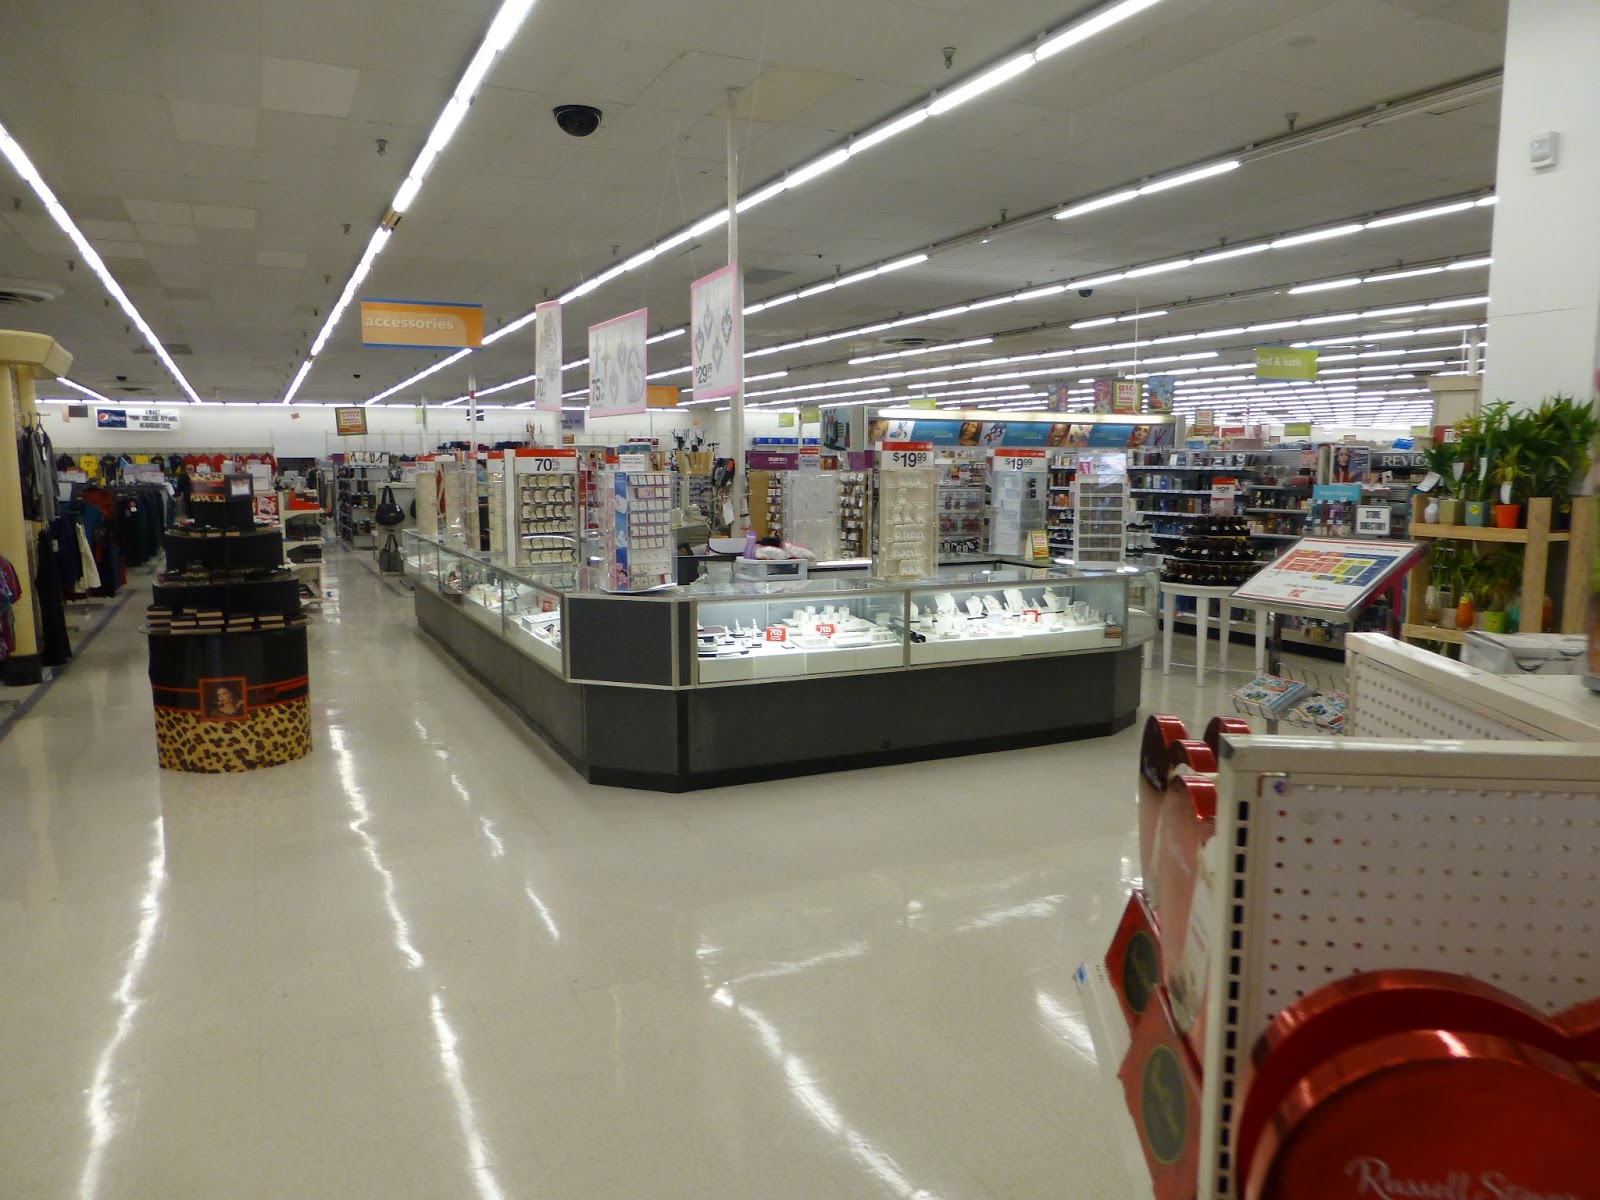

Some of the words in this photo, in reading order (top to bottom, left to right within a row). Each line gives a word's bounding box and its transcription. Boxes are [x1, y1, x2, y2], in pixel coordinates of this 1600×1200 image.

[365, 317, 454, 330] accessories
[1256, 355, 1272, 366] bed
[1274, 356, 1282, 366] &
[1283, 357, 1302, 367] bath
[535, 458, 561, 472] 70%
[1359, 522, 1386, 531] DIRECTORY
